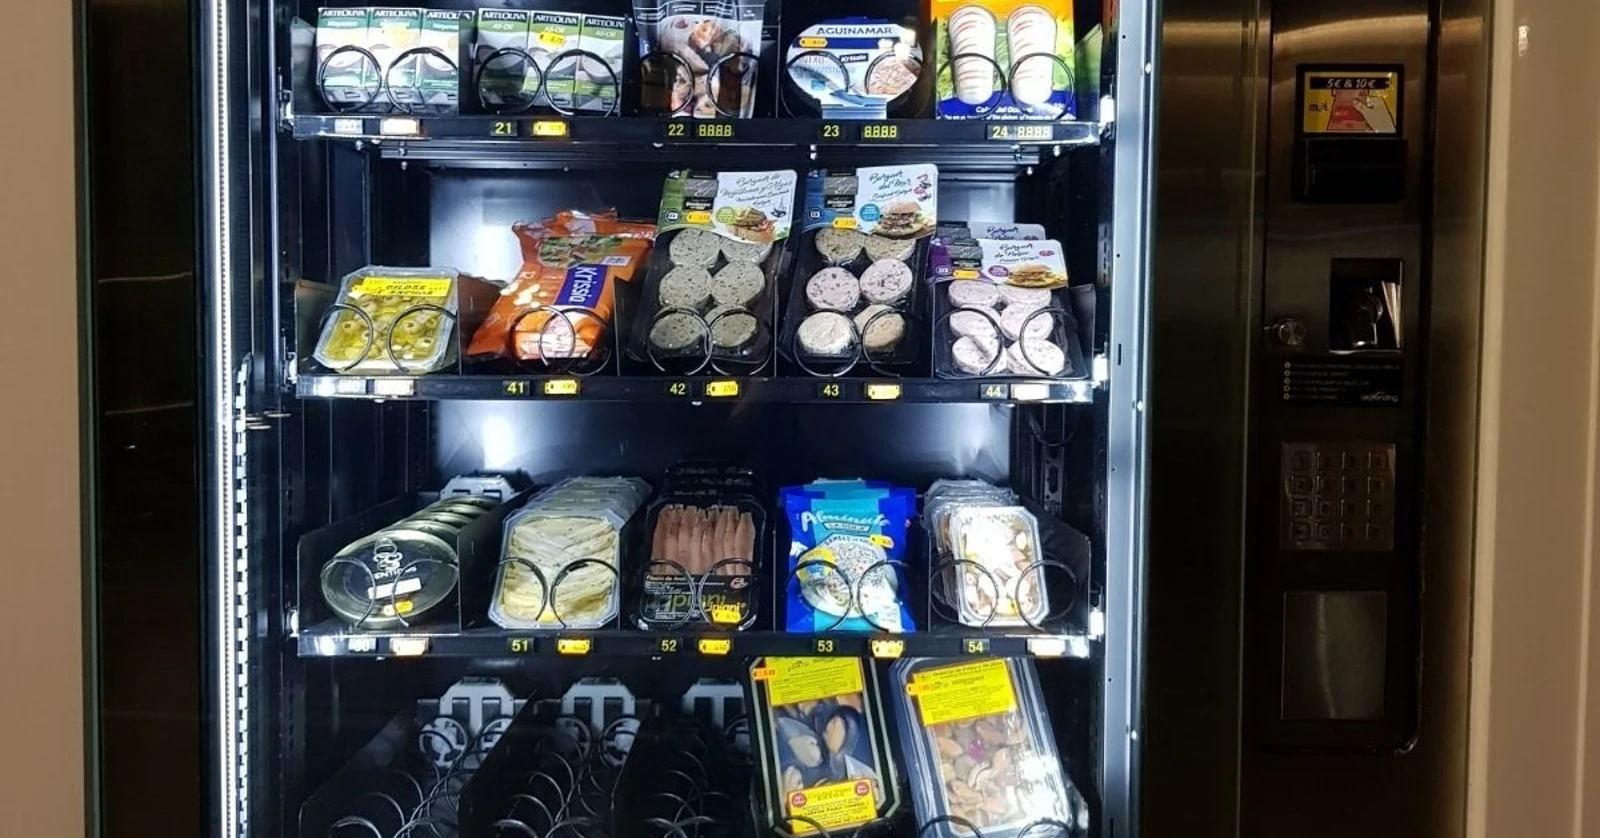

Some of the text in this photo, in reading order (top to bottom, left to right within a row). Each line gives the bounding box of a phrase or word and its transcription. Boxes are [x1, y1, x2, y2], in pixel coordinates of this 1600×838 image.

[322, 9, 366, 17] ARTEOLIVA
[375, 9, 418, 17] ARTEOLIVA
[483, 10, 526, 20] ARTEOLIVA
[535, 13, 577, 24] ARTEOLIVA
[816, 26, 893, 35] AGUINAMAR
[495, 122, 512, 134] 21
[668, 124, 684, 137] 22
[823, 125, 840, 137] 23
[992, 126, 1008, 138] 24
[568, 267, 599, 303] Krissia
[508, 381, 525, 394] 41
[669, 382, 686, 395] 42
[823, 383, 840, 396] 43
[986, 384, 1002, 397] 44
[511, 639, 528, 652] 51
[660, 639, 677, 652] 52
[817, 639, 834, 653] 53
[968, 639, 984, 653] 54
